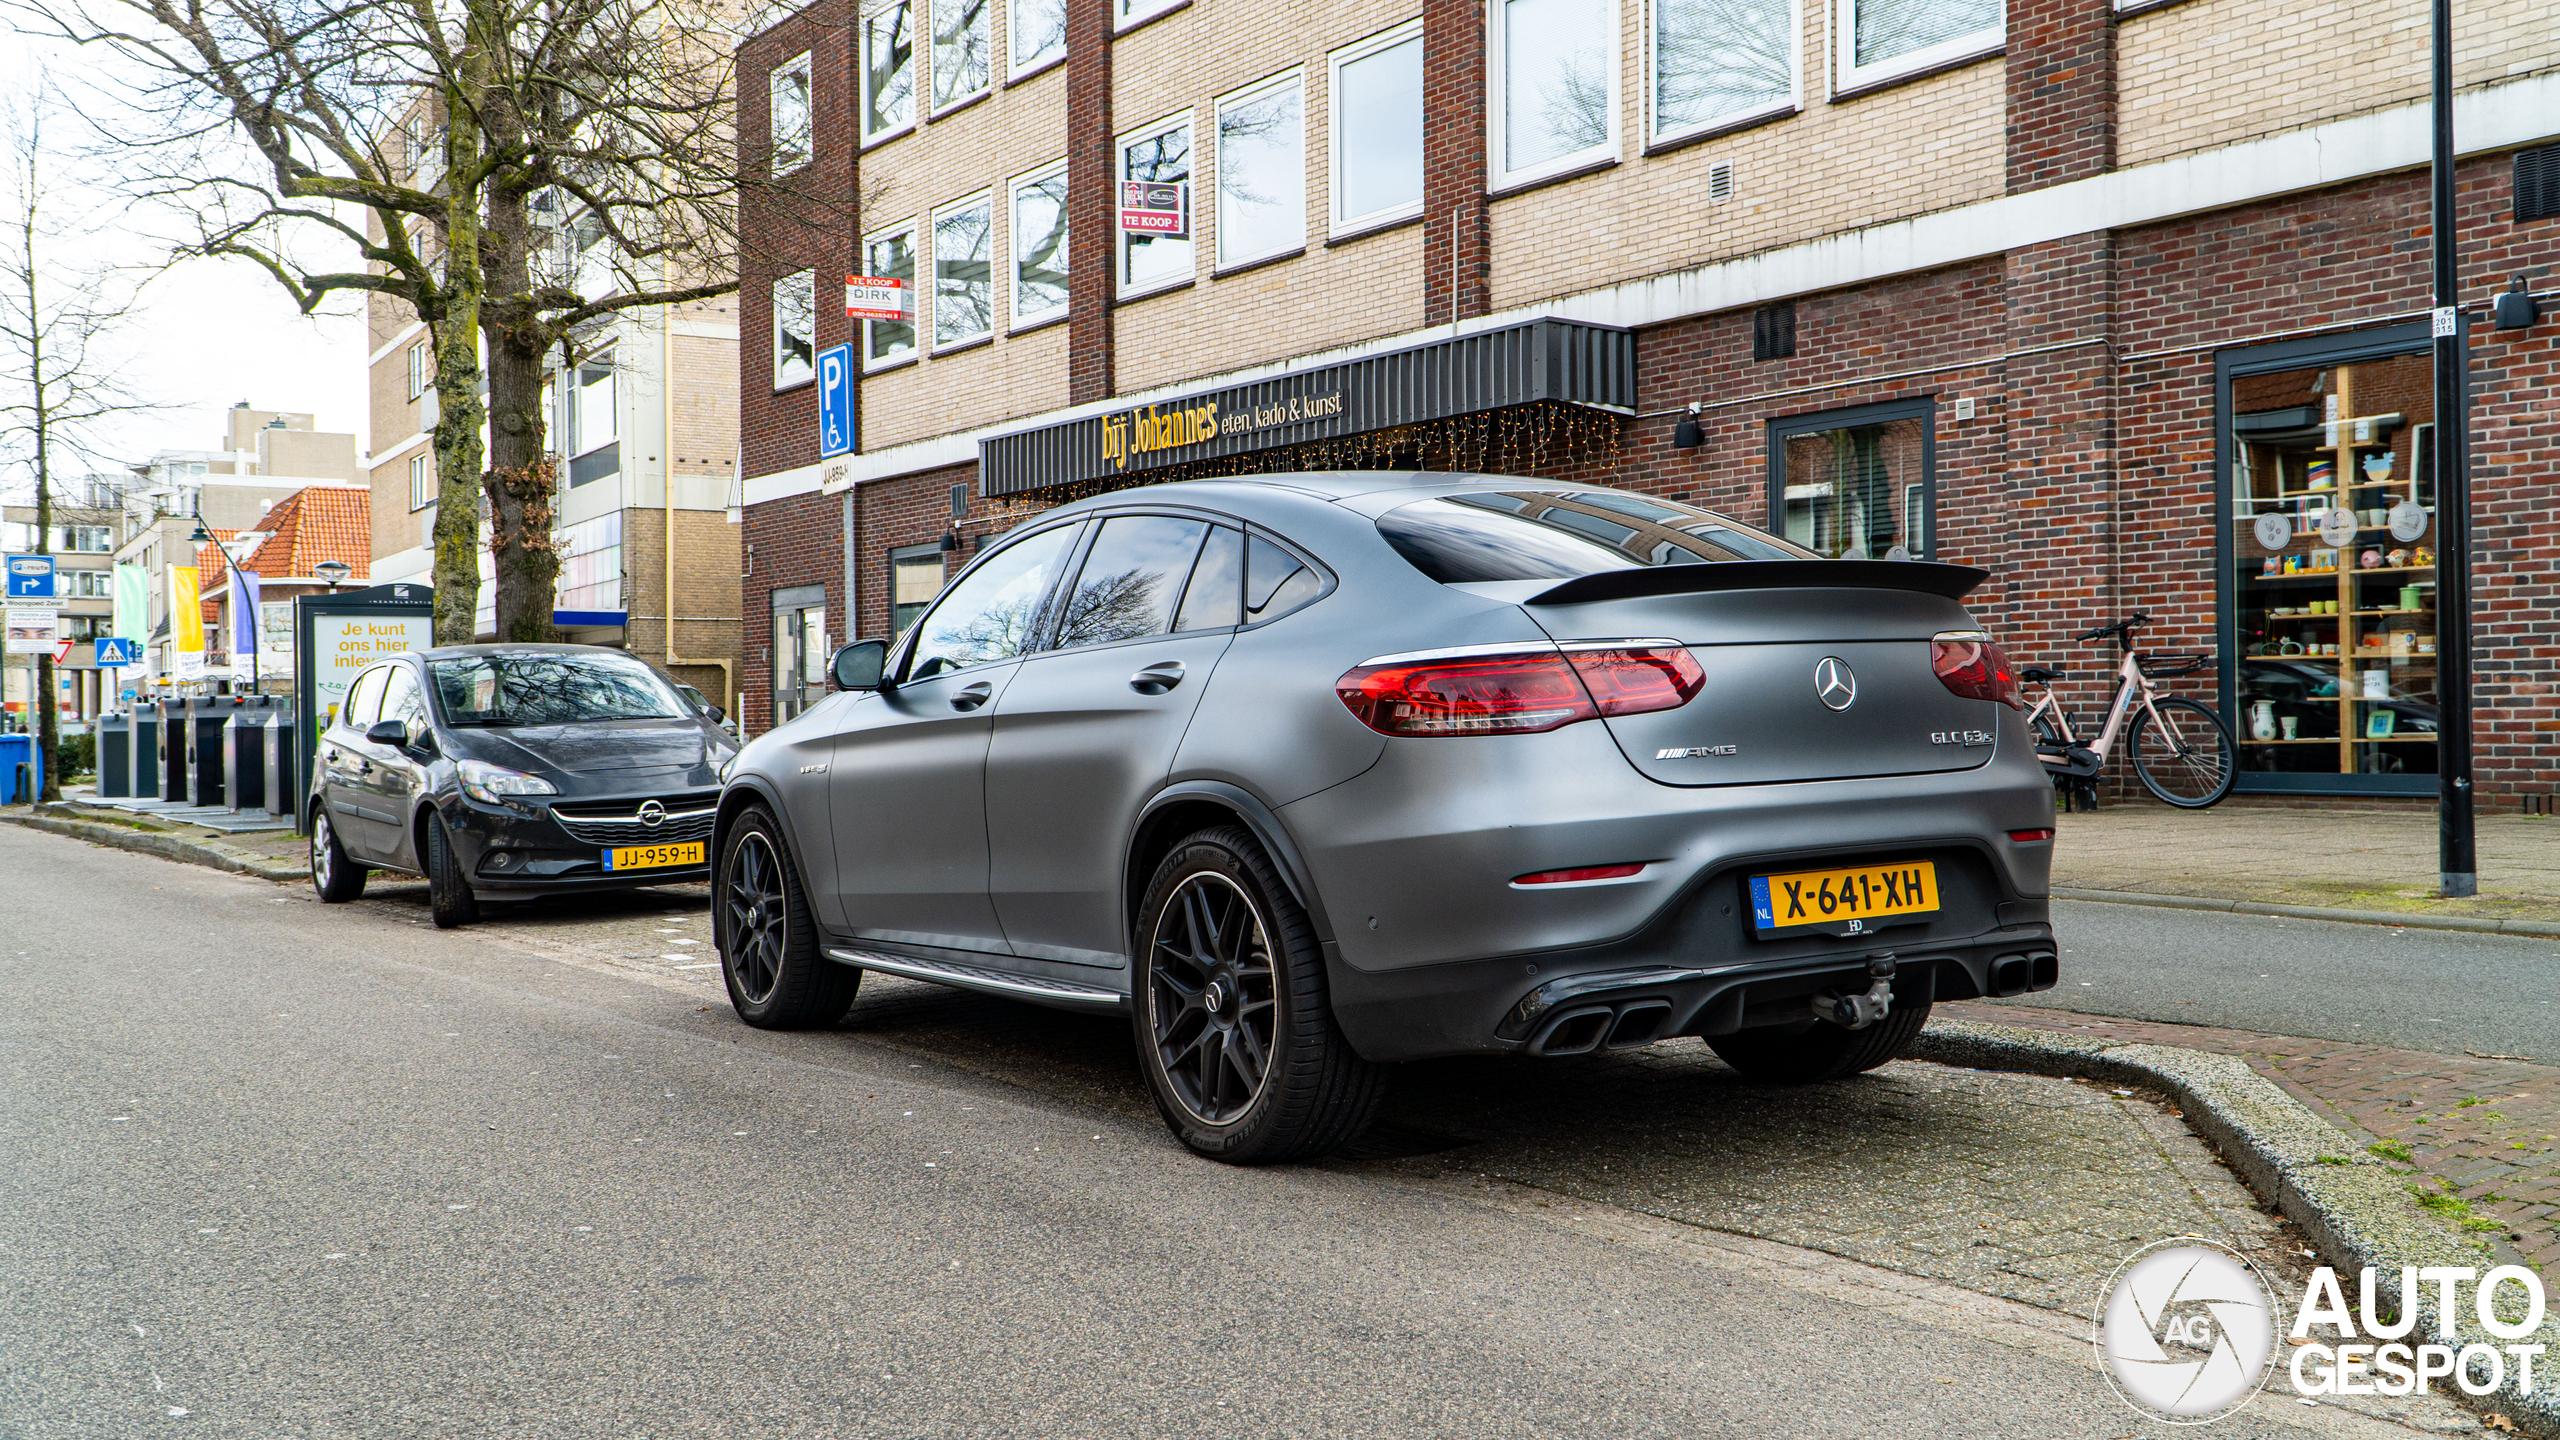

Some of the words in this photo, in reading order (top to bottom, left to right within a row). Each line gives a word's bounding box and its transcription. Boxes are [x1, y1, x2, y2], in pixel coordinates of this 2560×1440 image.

[1124, 216, 1139, 226] TE
[1141, 216, 1172, 227] KOOP
[852, 277, 865, 285] TE
[866, 278, 893, 286] KOOP
[854, 288, 891, 301] DIRK
[2435, 317, 2452, 326] 201
[2435, 324, 2453, 334] 015
[823, 356, 842, 411] P
[1102, 415, 1128, 468] bij
[1131, 402, 1218, 454] Johannes
[1221, 413, 1253, 435] eten,
[1255, 402, 1287, 428] kado
[1289, 398, 1302, 421] &
[1304, 392, 1343, 419] kunst
[823, 463, 849, 485] JJ-959-H
[341, 622, 363, 636] Je
[368, 622, 406, 636] kunt
[339, 640, 370, 652] ons
[376, 638, 410, 652] hier
[335, 654, 379, 668] inlev
[1931, 731, 1961, 745] GLC
[1678, 744, 1737, 759] AMG
[620, 845, 698, 867] JJ-959-H
[1145, 850, 1185, 906] MICHELIN
[1783, 868, 1925, 919] X-641-XH
[1757, 908, 1771, 920] NL
[1848, 919, 1863, 932] HD
[1226, 1096, 1270, 1148] MICHELIN
